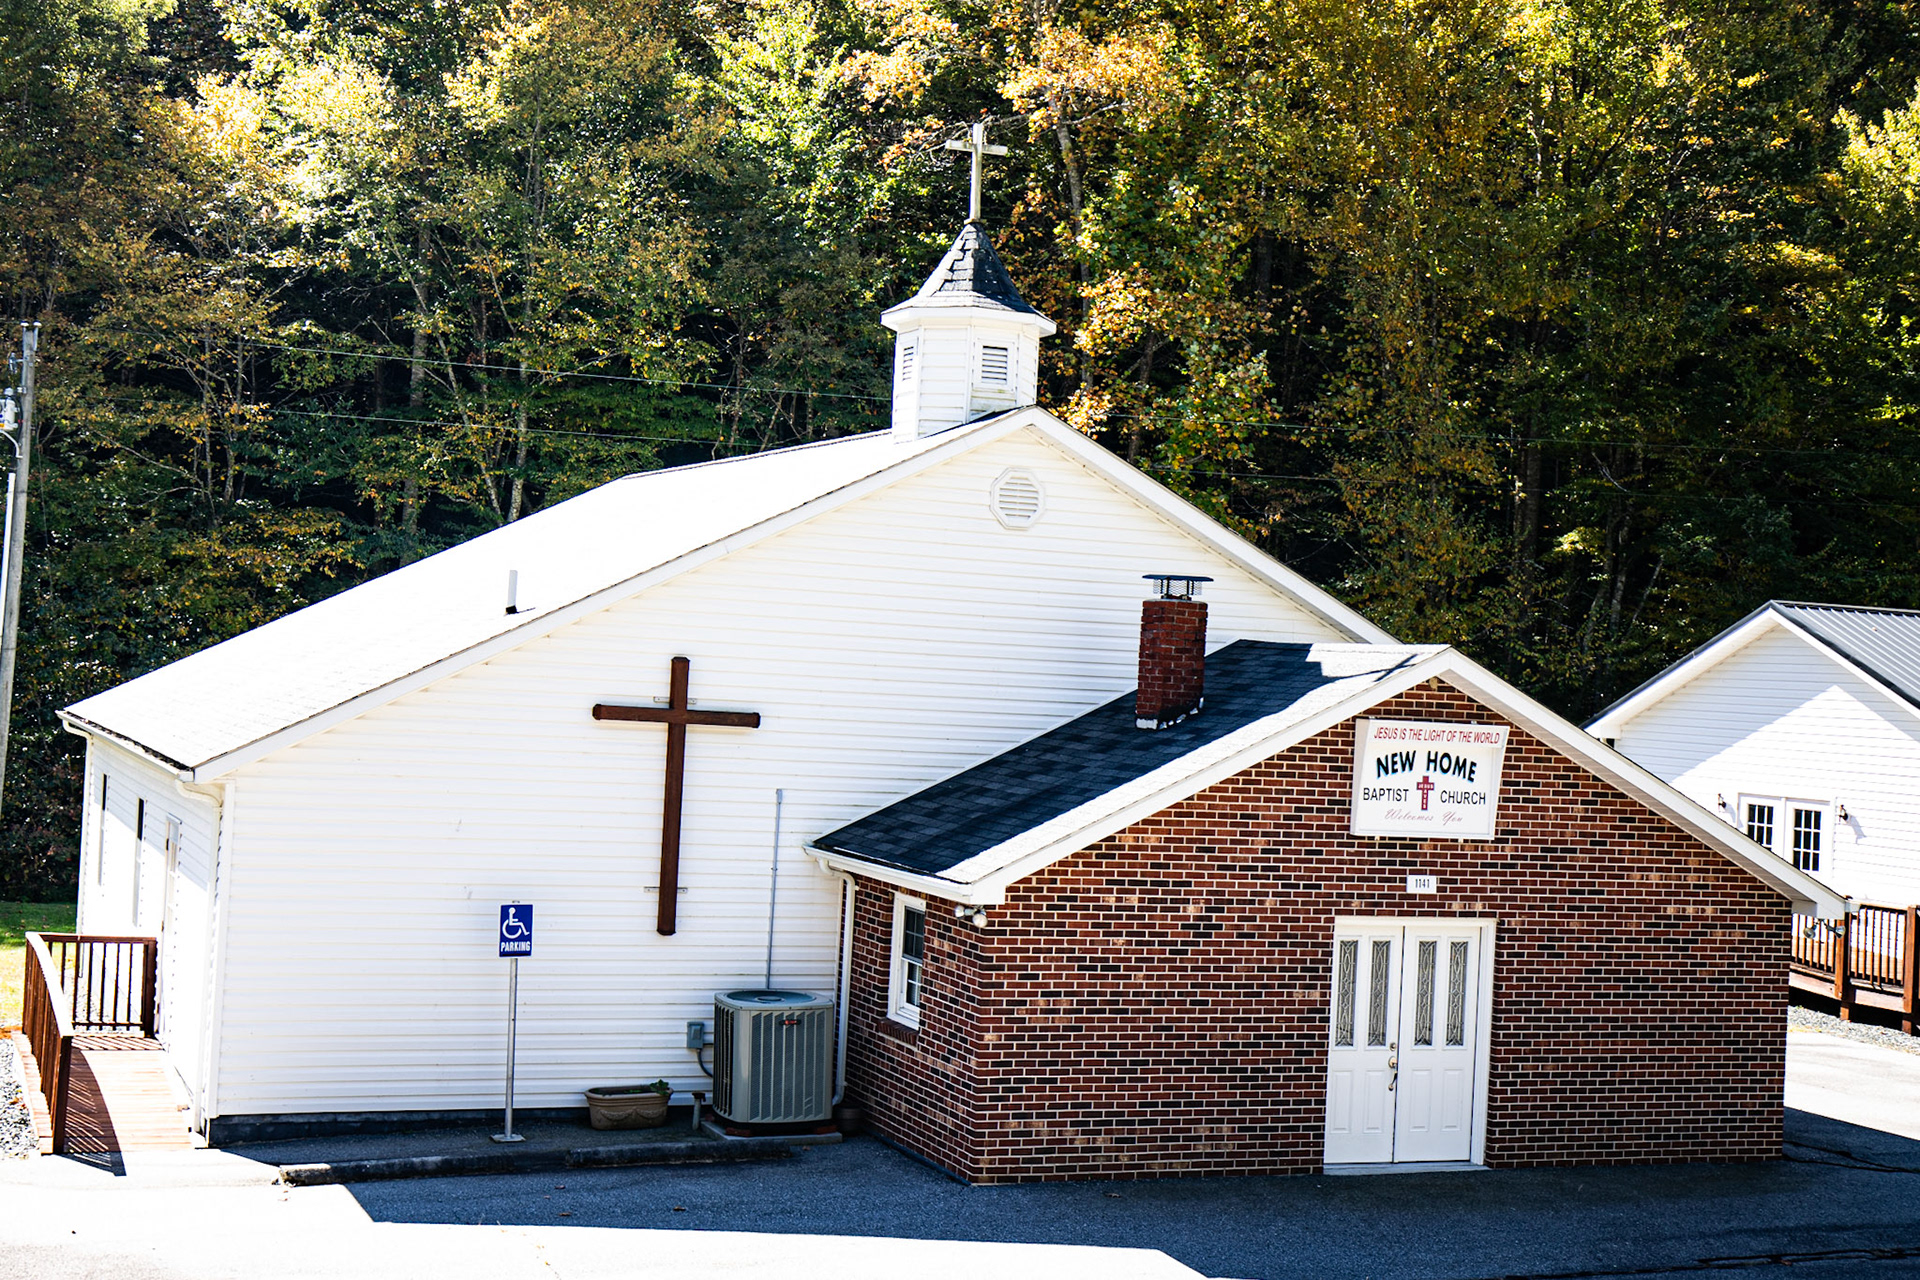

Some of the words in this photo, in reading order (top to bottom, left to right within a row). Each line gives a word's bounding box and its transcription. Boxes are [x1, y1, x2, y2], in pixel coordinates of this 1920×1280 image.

[1374, 728, 1398, 739] JESUS
[1399, 729, 1407, 739] IS
[1409, 729, 1422, 740] THE
[1424, 730, 1445, 741] LIGHT
[1446, 731, 1457, 742] OF
[1458, 731, 1472, 742] THE
[1473, 732, 1500, 744] WORLD
[1377, 750, 1416, 778] NEW
[1426, 751, 1477, 782] HOME
[1363, 788, 1409, 801] BAPTIST
[1440, 790, 1486, 804] CHURCH
[1385, 809, 1433, 821] Welcomes
[1442, 811, 1463, 825] You
[501, 941, 530, 952] PARKING
